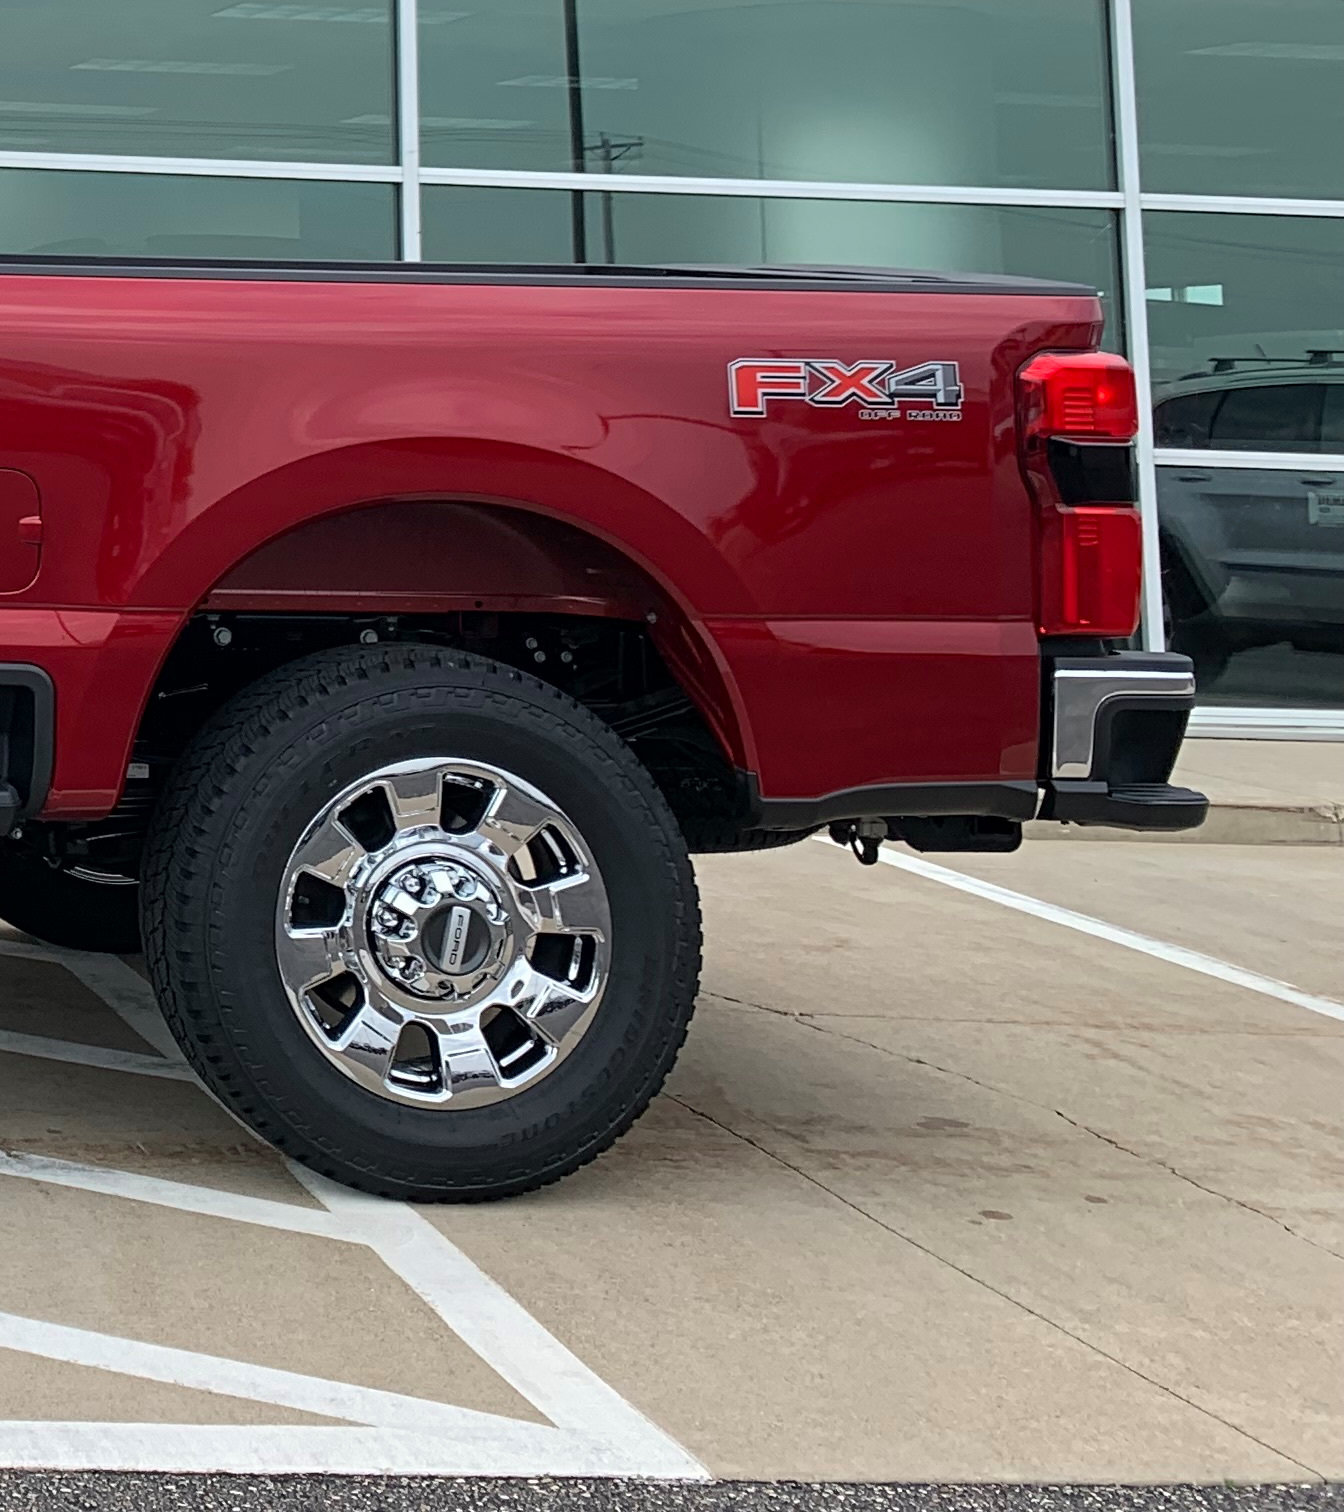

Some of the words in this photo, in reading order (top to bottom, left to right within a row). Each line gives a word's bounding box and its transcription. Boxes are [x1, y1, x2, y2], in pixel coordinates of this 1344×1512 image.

[727, 358, 965, 418] FX4
[858, 409, 901, 421] OFF
[906, 410, 963, 421] ROAD
[448, 914, 465, 966] FORD
